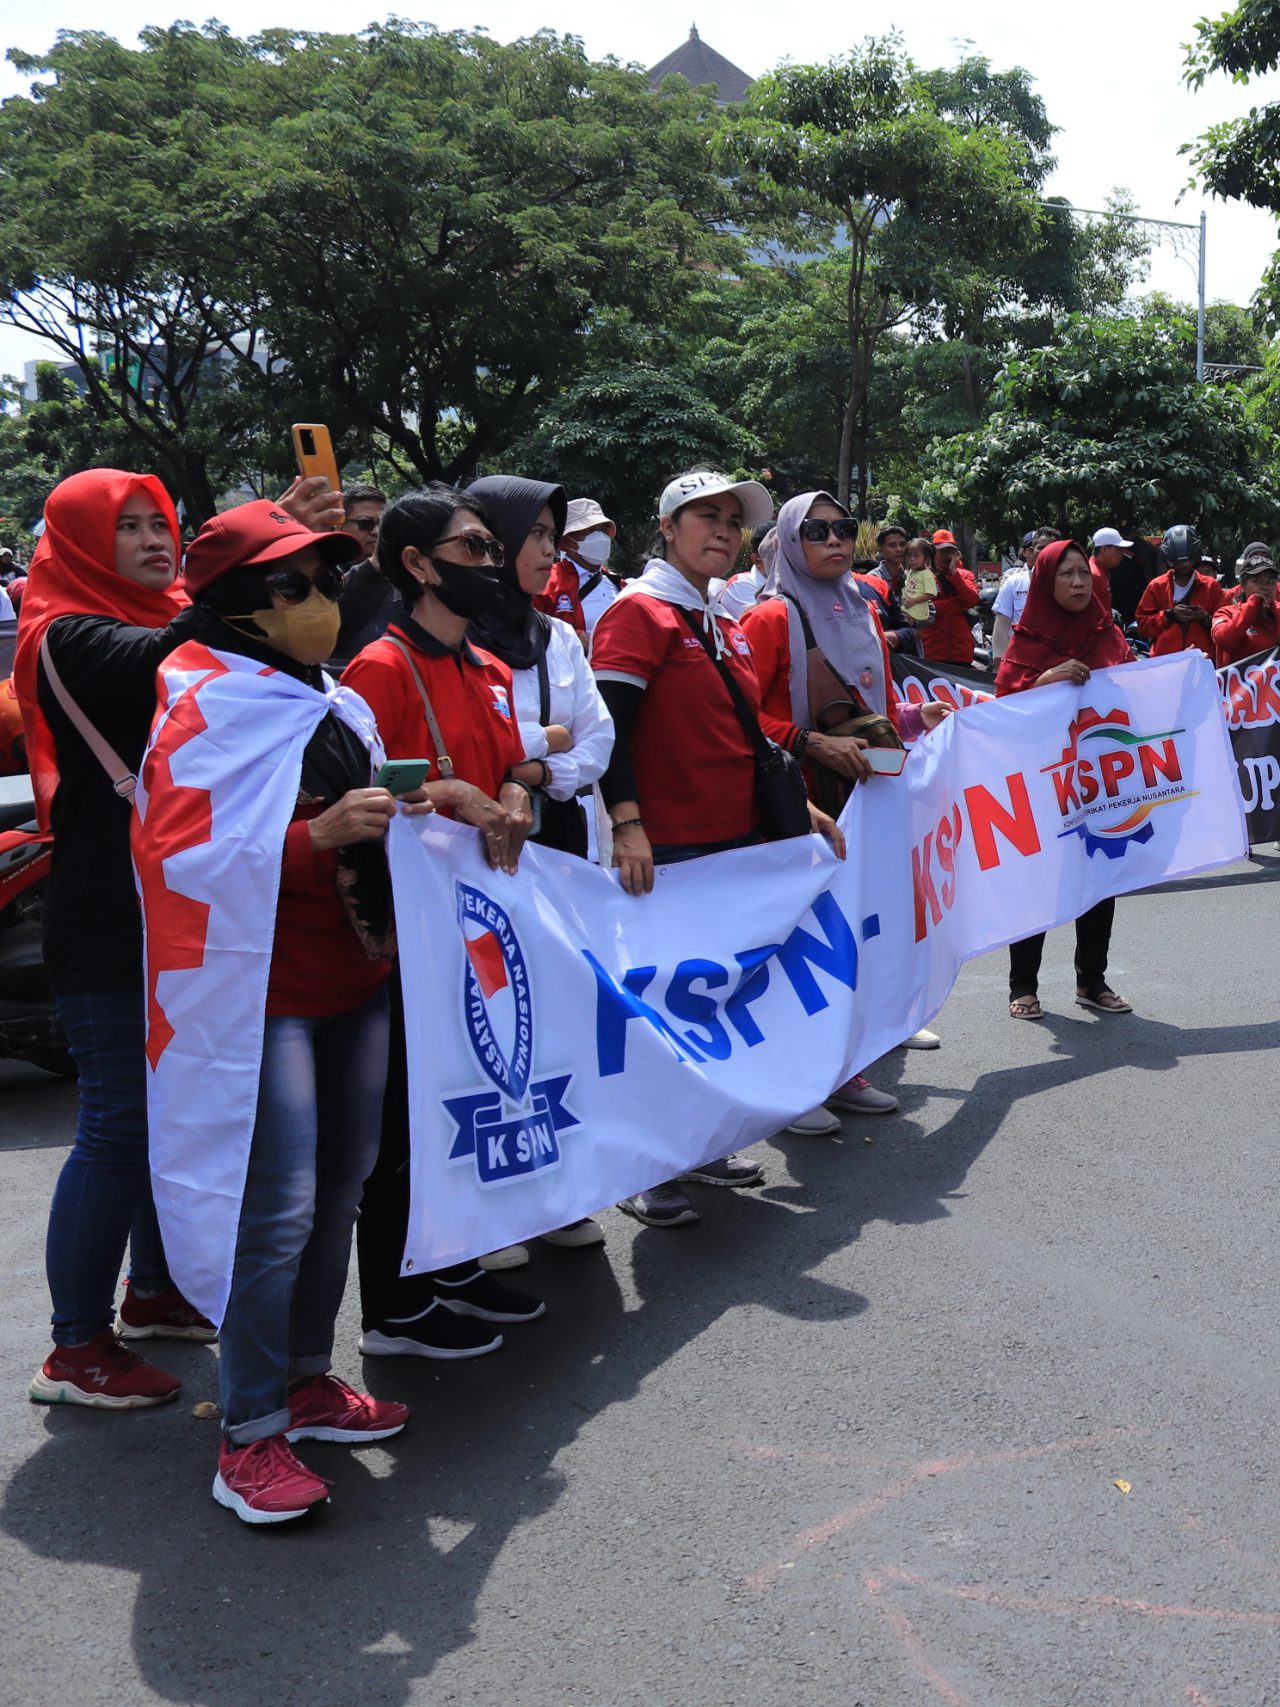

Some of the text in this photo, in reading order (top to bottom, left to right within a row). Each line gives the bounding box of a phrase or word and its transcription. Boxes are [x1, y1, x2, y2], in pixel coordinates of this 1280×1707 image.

[1052, 738, 1183, 817] KSPN
[1108, 796, 1142, 811] PEKERJA
[1142, 785, 1186, 801] NUSANTARA
[511, 964, 530, 1080] NASIONAL
